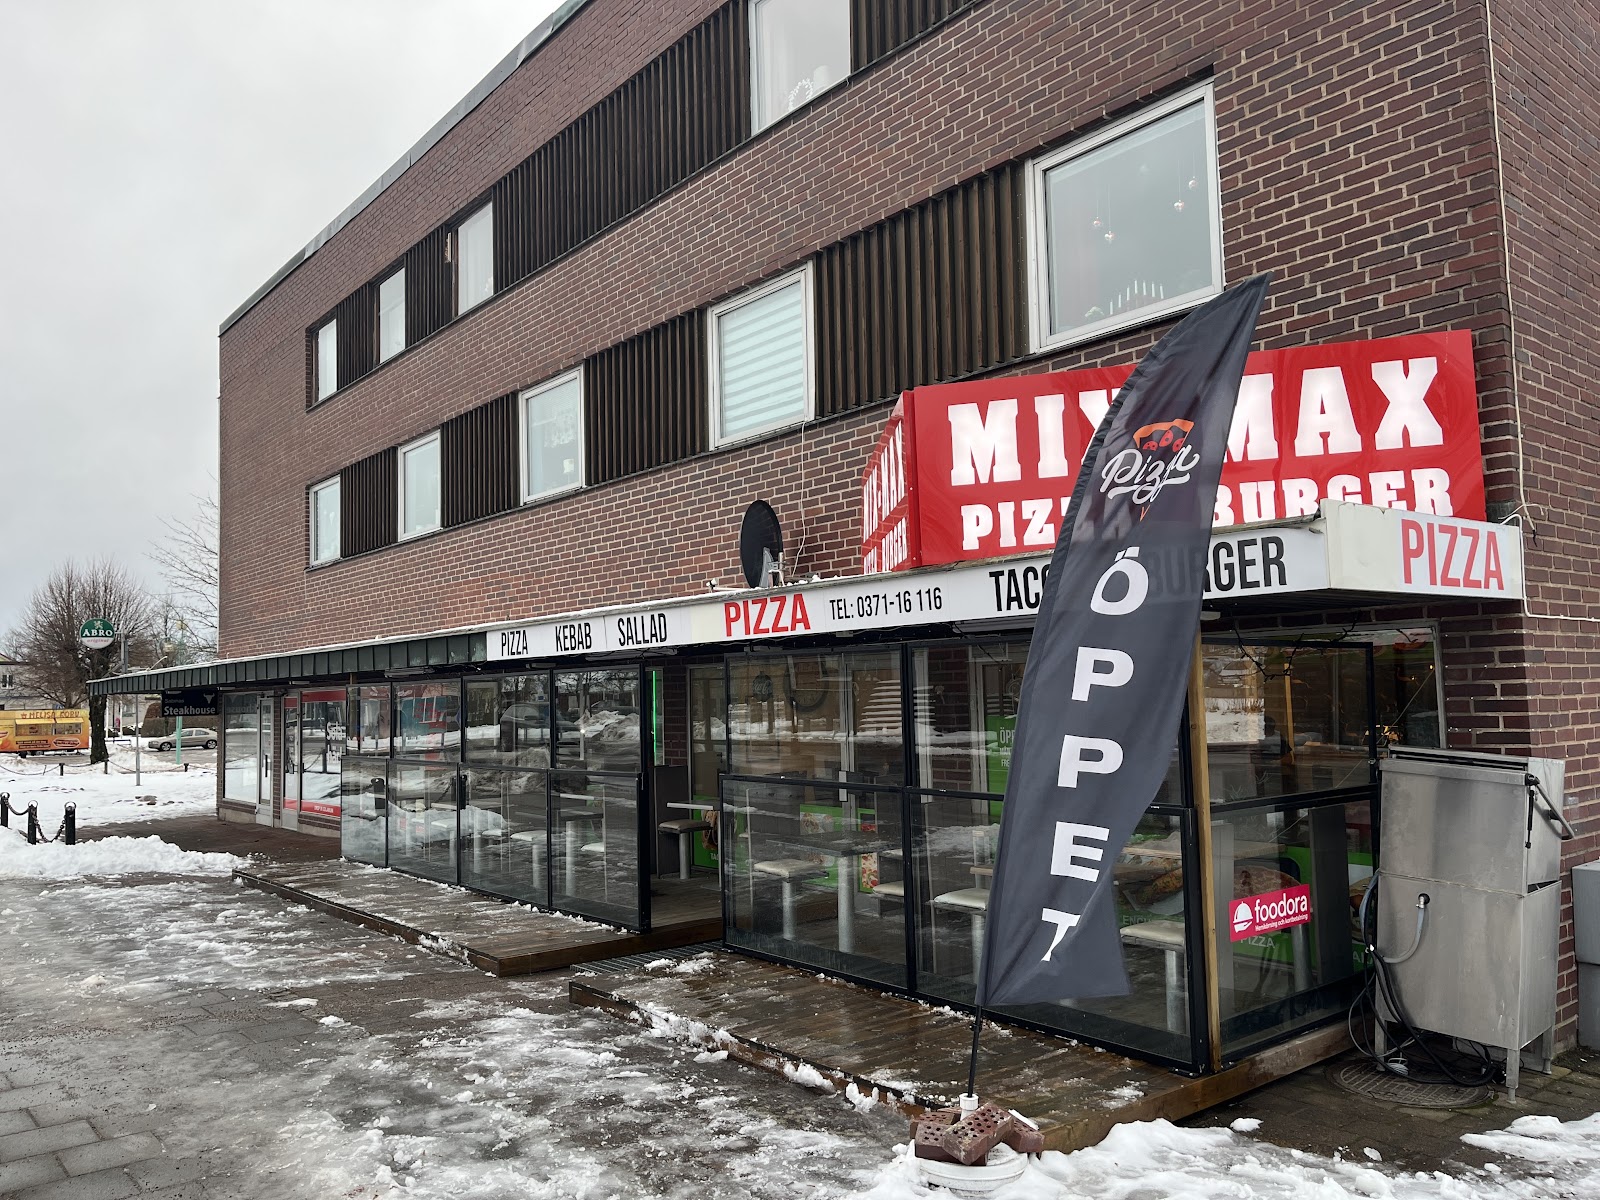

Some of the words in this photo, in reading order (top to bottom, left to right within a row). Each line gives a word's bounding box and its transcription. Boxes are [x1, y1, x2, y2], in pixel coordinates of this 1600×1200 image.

[1401, 518, 1504, 591] PIZZA
[724, 593, 810, 637] PIZZA
[829, 598, 854, 620] TEL:
[857, 590, 912, 618] 0371-16
[916, 587, 942, 611] 116
[501, 629, 528, 656] PIZZA
[555, 622, 592, 652] KEBAB
[618, 612, 667, 646] SALLAD
[163, 705, 216, 716] Steakhouse
[1041, 546, 1149, 962] ÖPPET
[1254, 892, 1308, 923] foodora
